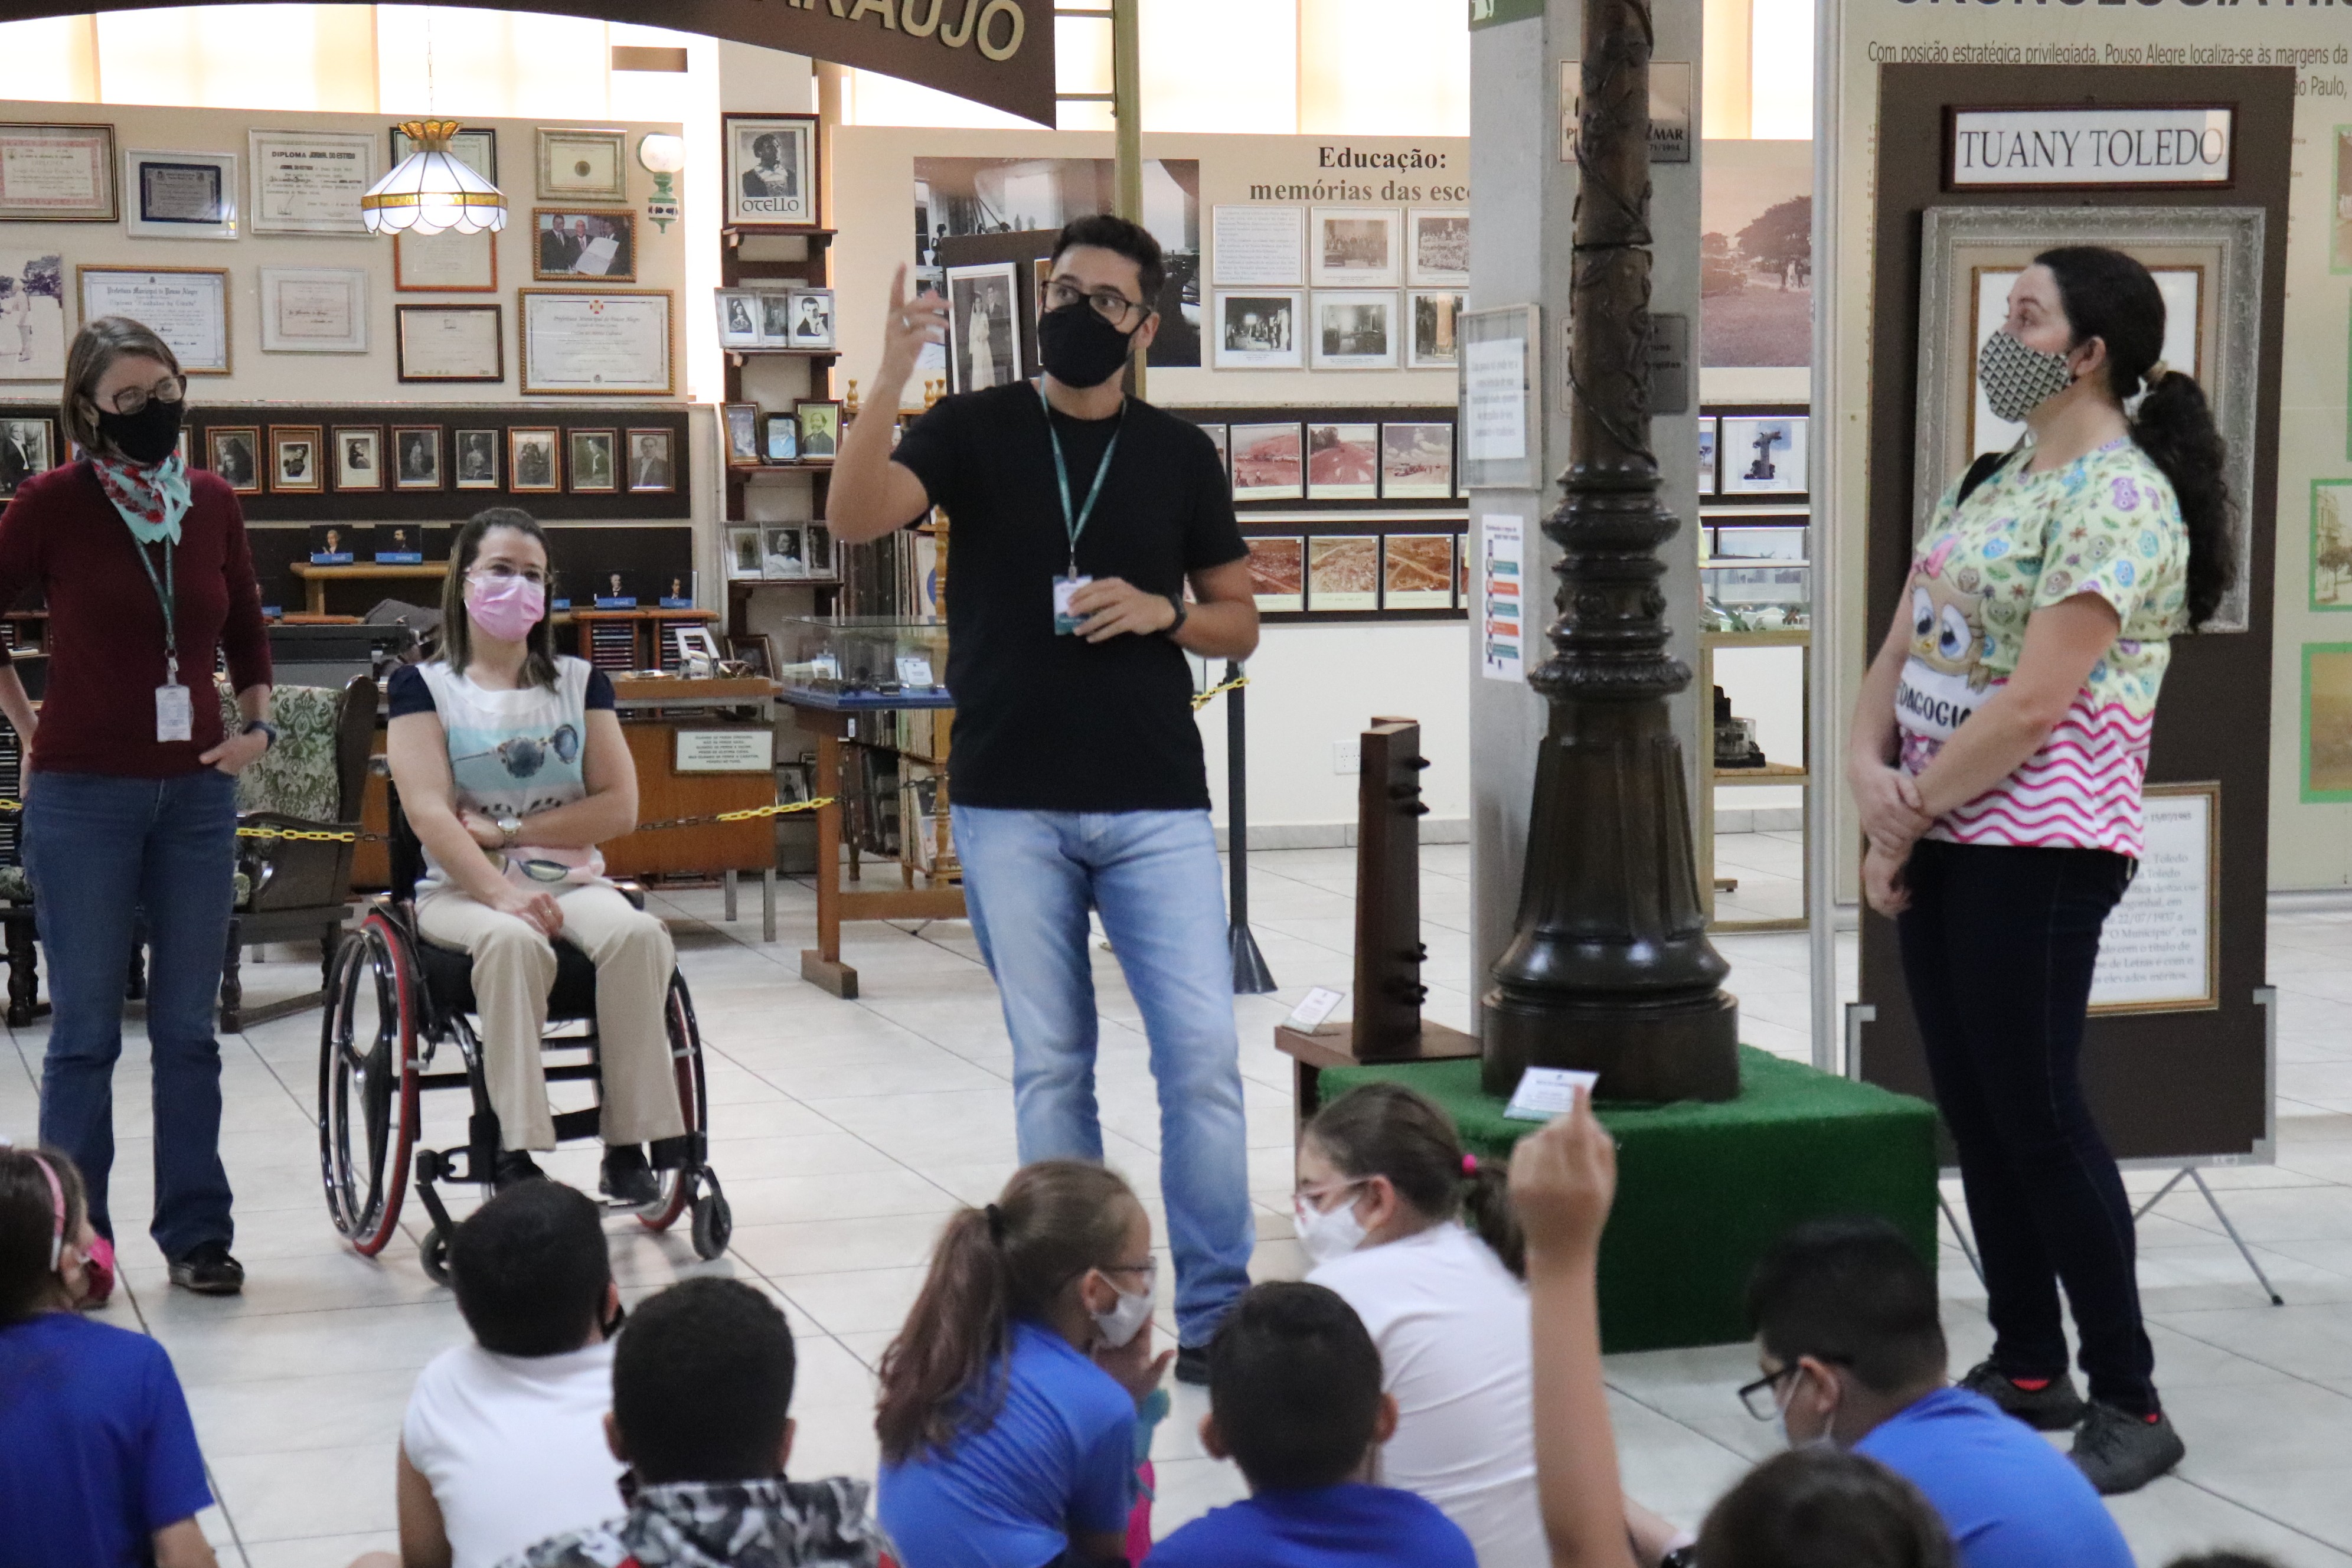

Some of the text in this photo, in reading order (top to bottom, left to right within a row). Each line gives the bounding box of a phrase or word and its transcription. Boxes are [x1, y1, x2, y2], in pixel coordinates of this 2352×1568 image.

[1868, 41, 1896, 61] Com
[1902, 41, 1948, 63] posição
[1953, 40, 2020, 64] estratégica
[2026, 43, 2100, 64] privilegiada,
[2106, 44, 2142, 63] Pouso
[2147, 44, 2185, 65] Alegre
[2190, 43, 2253, 64] localiza-se
[2276, 48, 2328, 69] margens
[2333, 44, 2348, 64] da
[2311, 76, 2347, 100] Paulo,
[1318, 146, 1446, 174] Educação:
[1960, 128, 2224, 168] TUANY TOLEDO
[1249, 179, 1373, 201] memórias
[1381, 180, 1422, 201] das
[742, 198, 799, 212] OTELLO
[1896, 681, 1972, 729] DAGOGI
[2154, 853, 2188, 864] Toledo
[2148, 868, 2181, 879] Toledo
